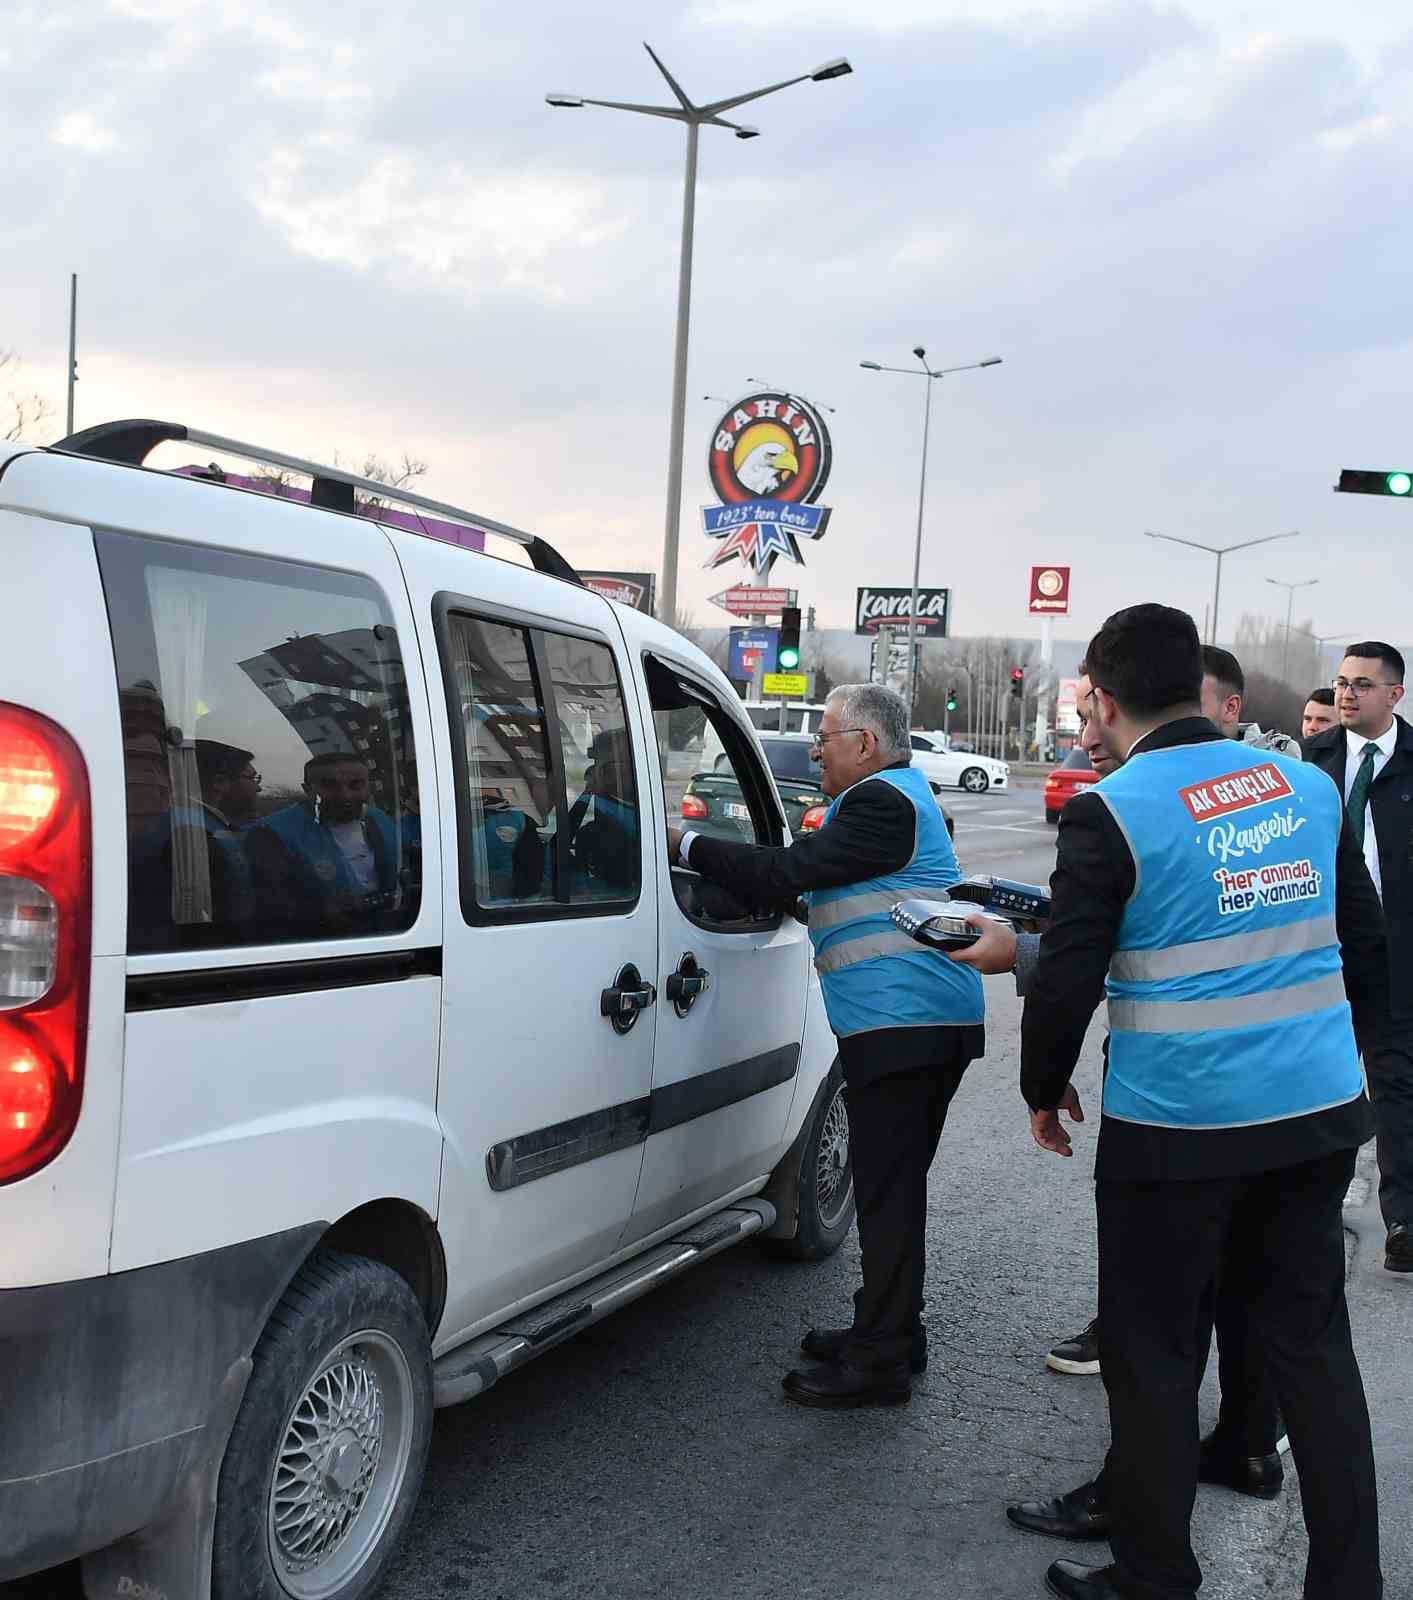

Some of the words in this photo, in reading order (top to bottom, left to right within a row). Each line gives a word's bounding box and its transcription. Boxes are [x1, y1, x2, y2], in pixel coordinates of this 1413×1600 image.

[1188, 788, 1216, 814] AK
[1213, 768, 1281, 802] GENÇLİK
[1207, 807, 1307, 864] Kayseri
